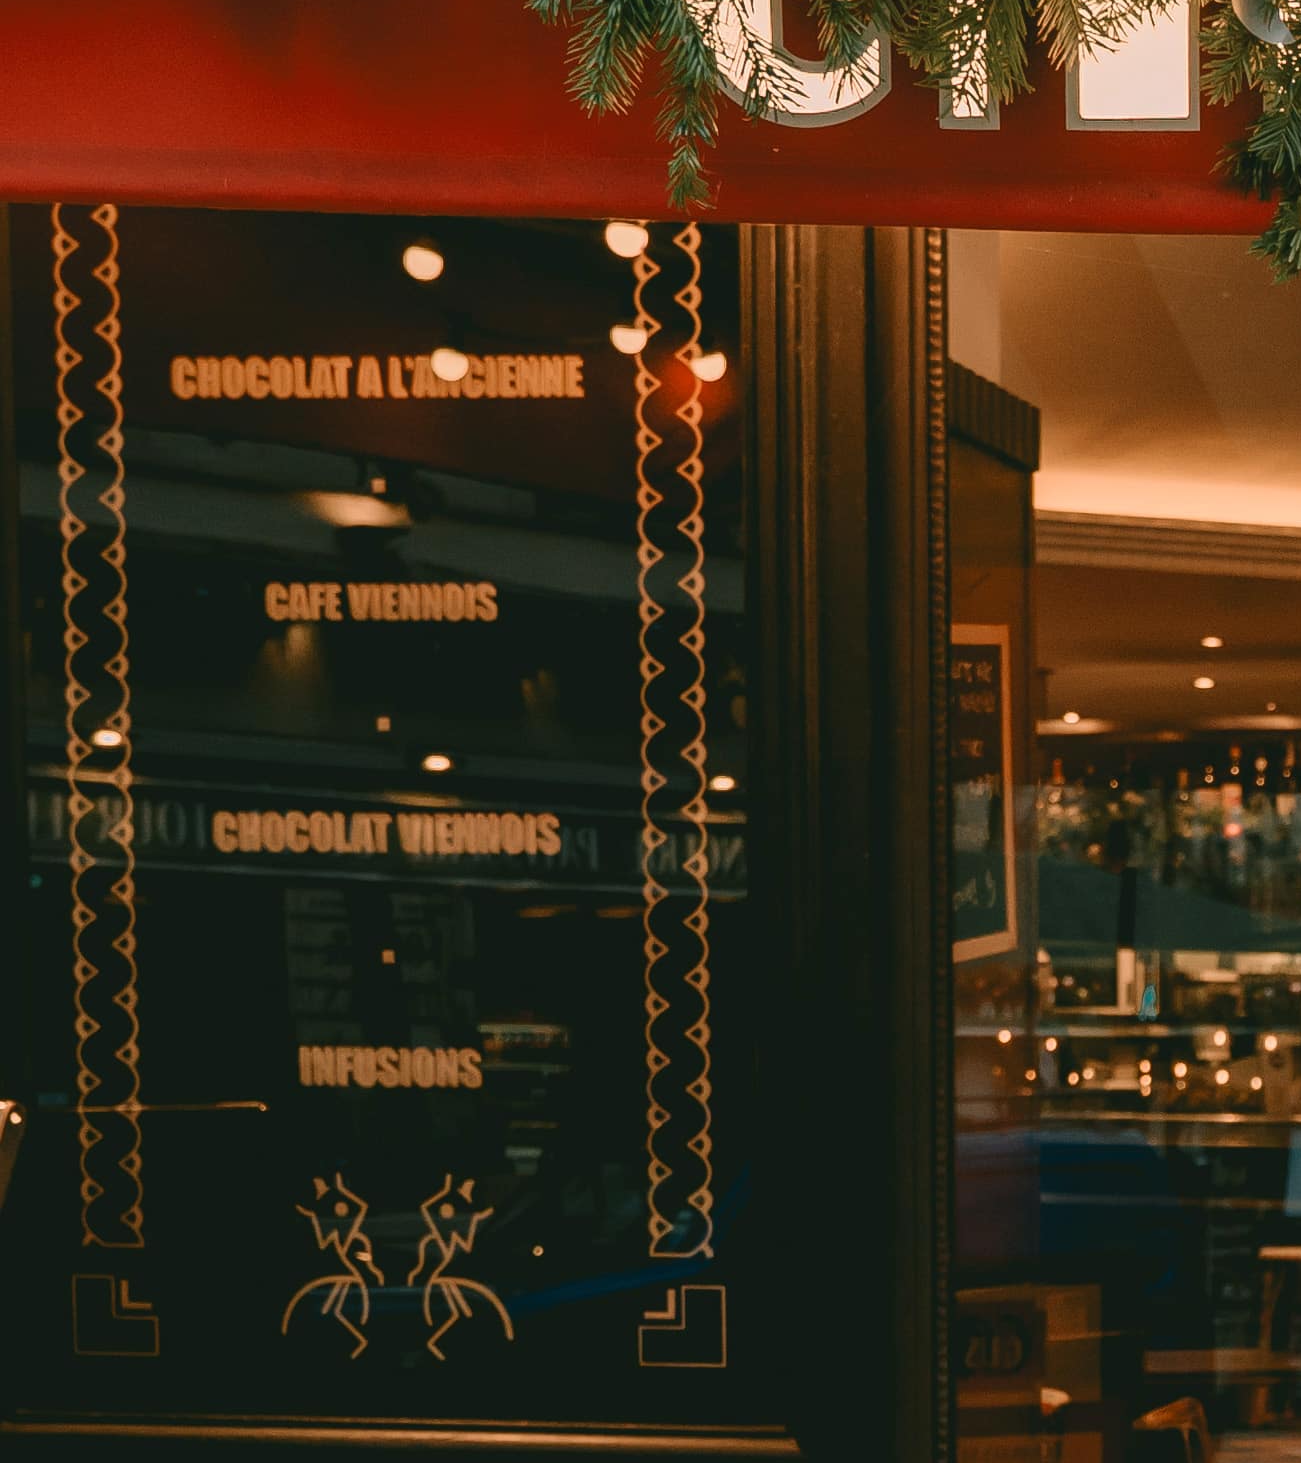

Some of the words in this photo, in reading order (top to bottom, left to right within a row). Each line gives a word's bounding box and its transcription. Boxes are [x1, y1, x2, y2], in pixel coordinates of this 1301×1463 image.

[171, 355, 353, 400] CHOCOLAT
[356, 356, 385, 399] A
[265, 581, 343, 621] CAFE
[346, 581, 498, 622] VIENNOIS
[212, 811, 392, 854] CHOCOLAT
[397, 812, 562, 856] VIENNOIS
[298, 1045, 483, 1088] INFUSIONS
